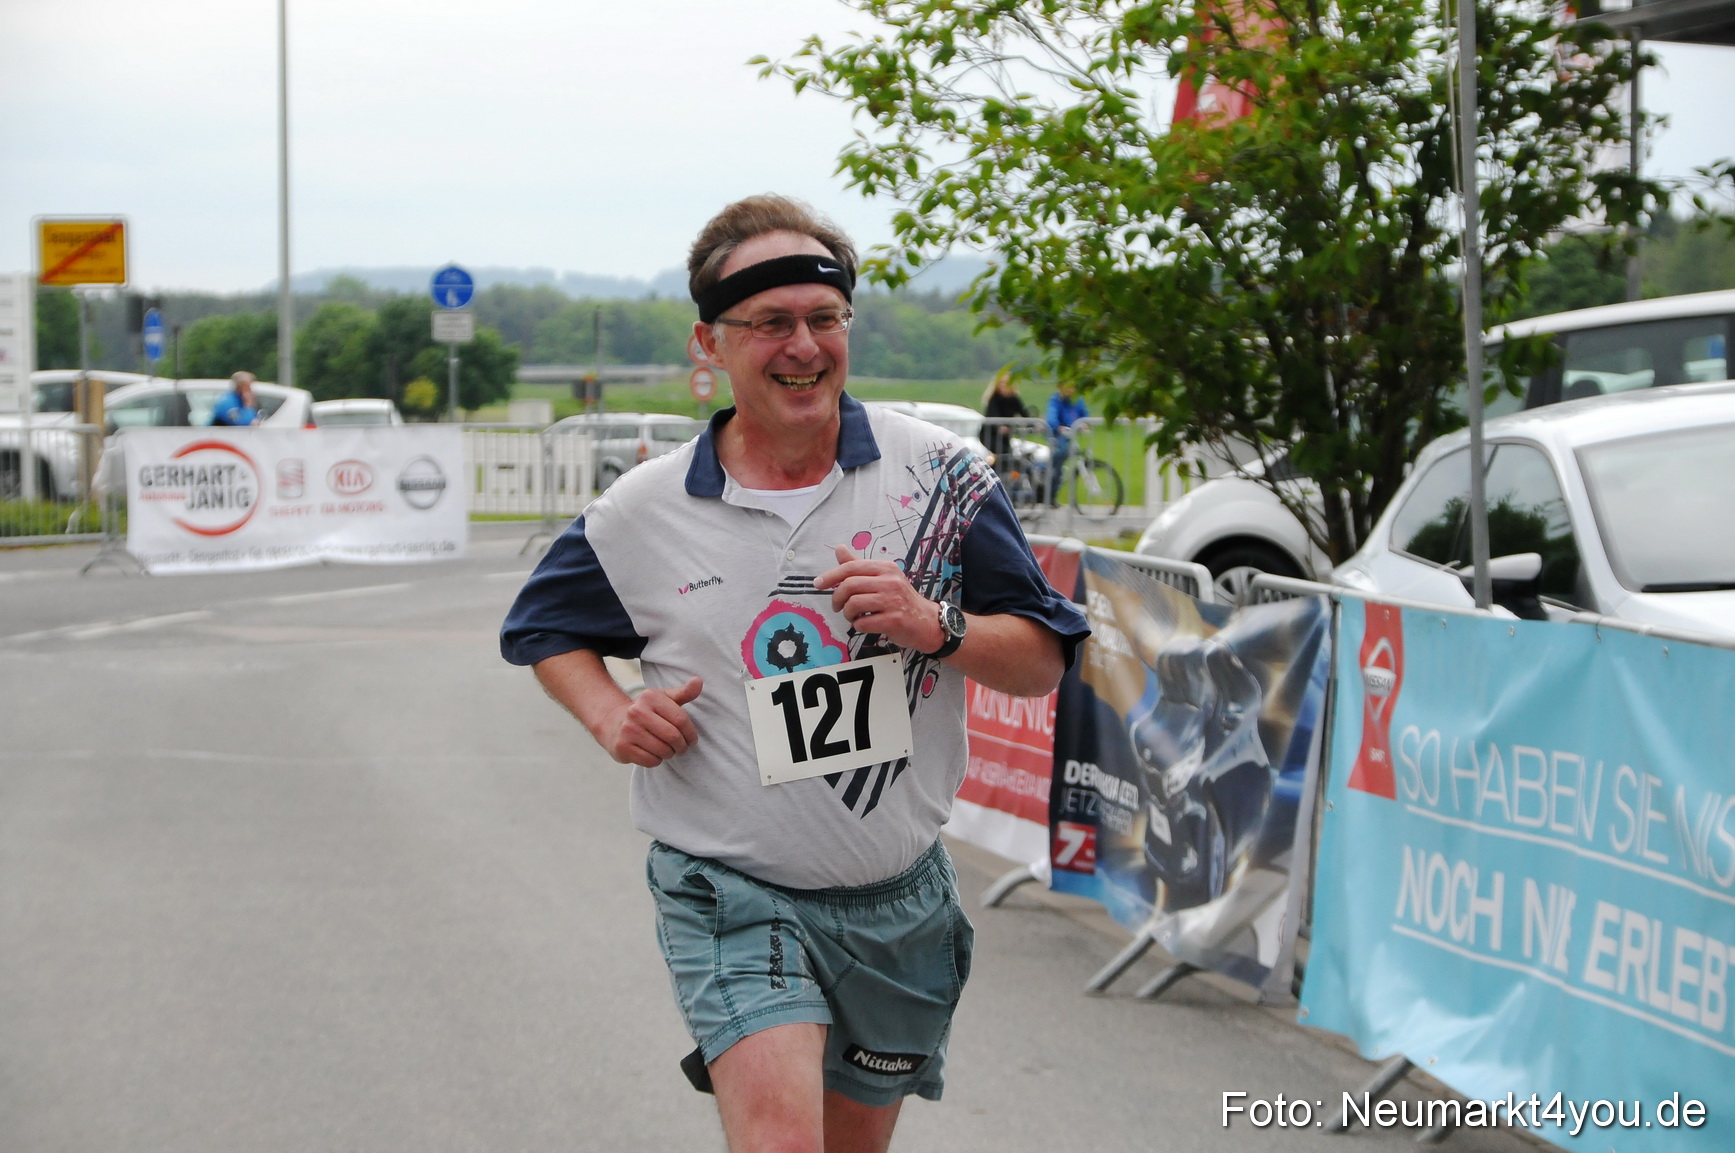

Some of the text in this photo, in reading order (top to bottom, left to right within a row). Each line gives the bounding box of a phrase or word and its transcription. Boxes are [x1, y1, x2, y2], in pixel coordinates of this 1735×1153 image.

[138, 464, 236, 487] GERHART
[333, 468, 365, 487] KIA
[689, 576, 721, 591] Butterfly
[771, 665, 874, 763] 127
[1400, 724, 1440, 807] SO
[1452, 737, 1604, 841] HABEN
[1609, 765, 1669, 864] SIE
[1055, 827, 1087, 865] 7
[1395, 844, 1504, 951] NOCH
[853, 1050, 912, 1071] Nittaku
